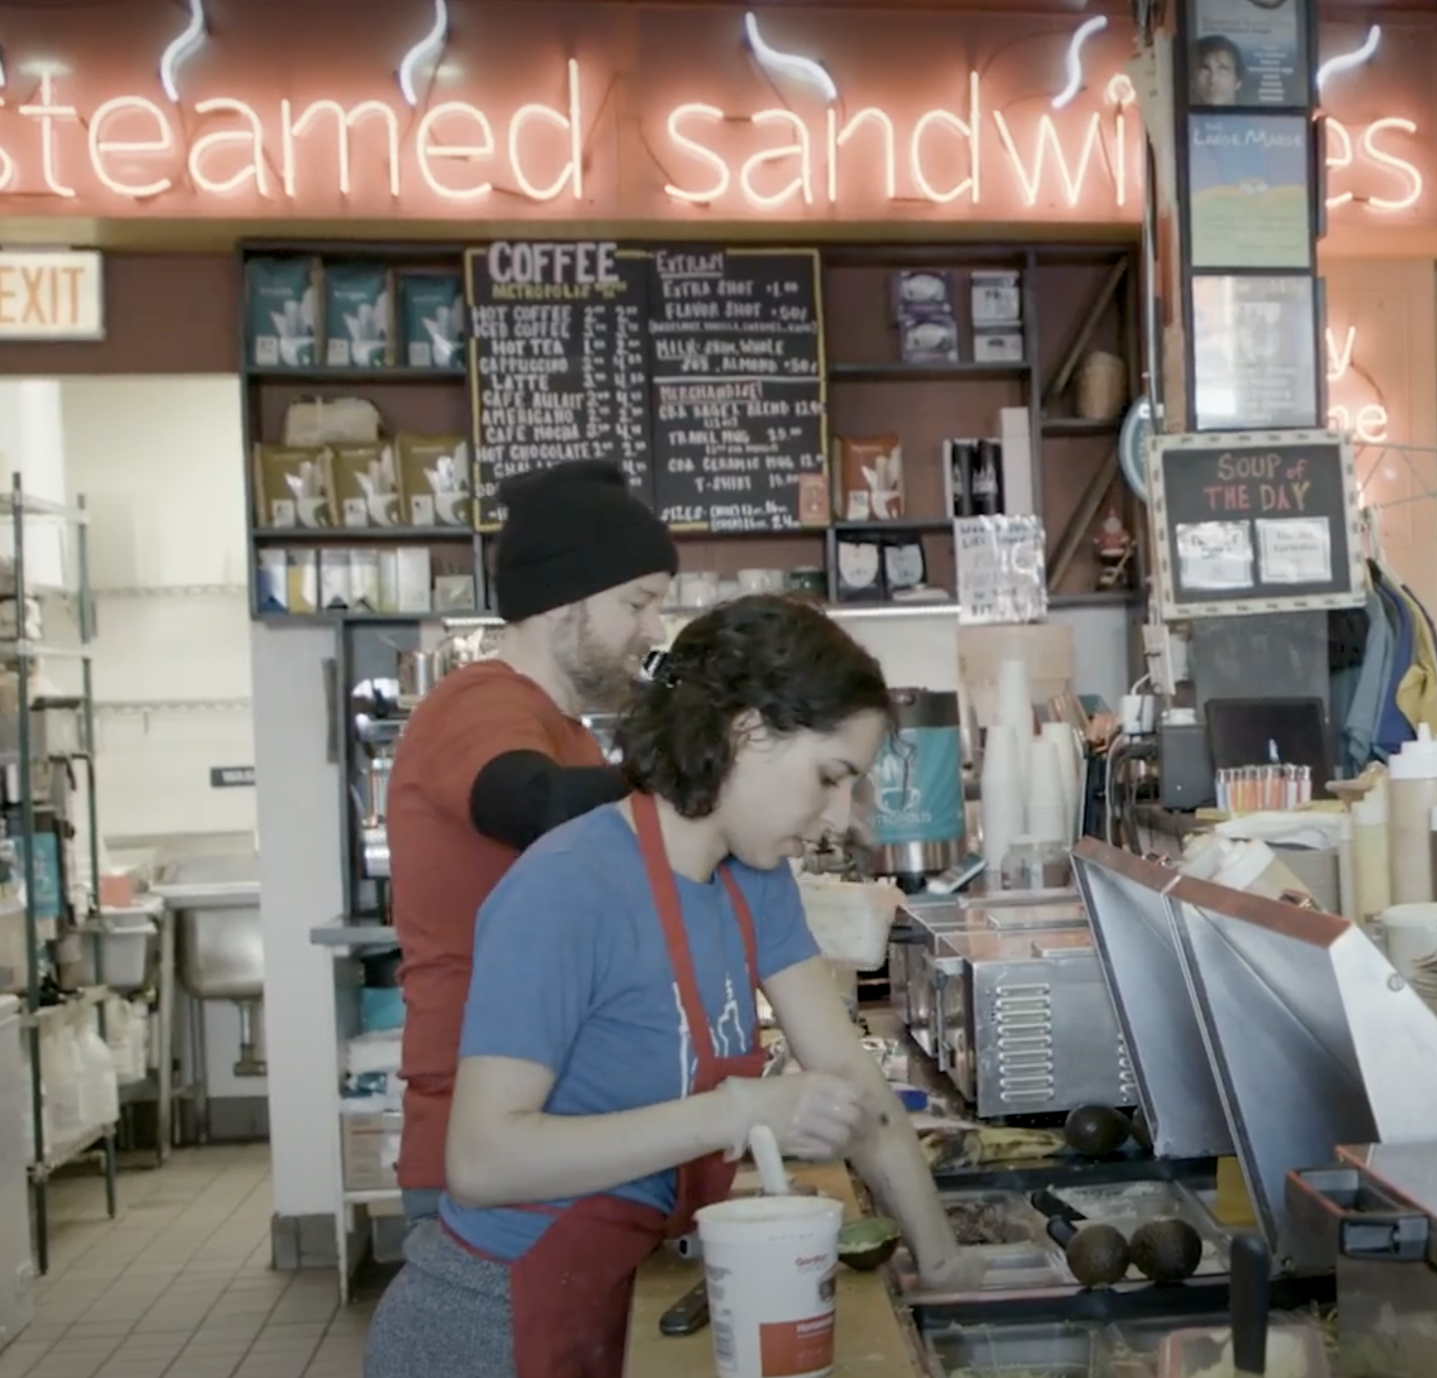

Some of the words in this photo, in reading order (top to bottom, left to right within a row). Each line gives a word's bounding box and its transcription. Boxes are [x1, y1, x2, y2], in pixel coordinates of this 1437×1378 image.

[0, 58, 583, 201] teamed
[488, 241, 620, 284] COFFEE
[0, 266, 85, 324] EXIT
[663, 280, 711, 298] EXTRA
[717, 280, 754, 296] SHOT
[472, 305, 508, 323] HOT
[513, 305, 572, 323] COFFEE
[665, 301, 720, 319] FLAVOR
[724, 300, 762, 318] SHOT
[514, 322, 570, 339] COFFEE
[491, 340, 526, 355] HOT
[530, 339, 564, 355] TEA
[740, 339, 784, 355] WHOLE
[479, 357, 569, 374] CAPPUCCINO
[722, 357, 778, 373] ALMOND
[491, 374, 550, 391] LATTE
[482, 390, 525, 408] CAFE
[482, 408, 574, 427] AMERICANO
[747, 401, 790, 417] BLEND
[486, 426, 526, 443] CAFE
[534, 424, 580, 442] MOCHA
[721, 431, 750, 444] MUG
[476, 445, 505, 462] HOT
[510, 442, 589, 461] CHOCOLATE
[703, 456, 760, 472] CERAMIC
[766, 456, 795, 470] MUG
[1218, 453, 1282, 480] SOUP
[1286, 459, 1308, 480] of
[695, 476, 752, 492] T-SHIRT
[1204, 484, 1249, 511] THE
[1260, 481, 1310, 511] DAY
